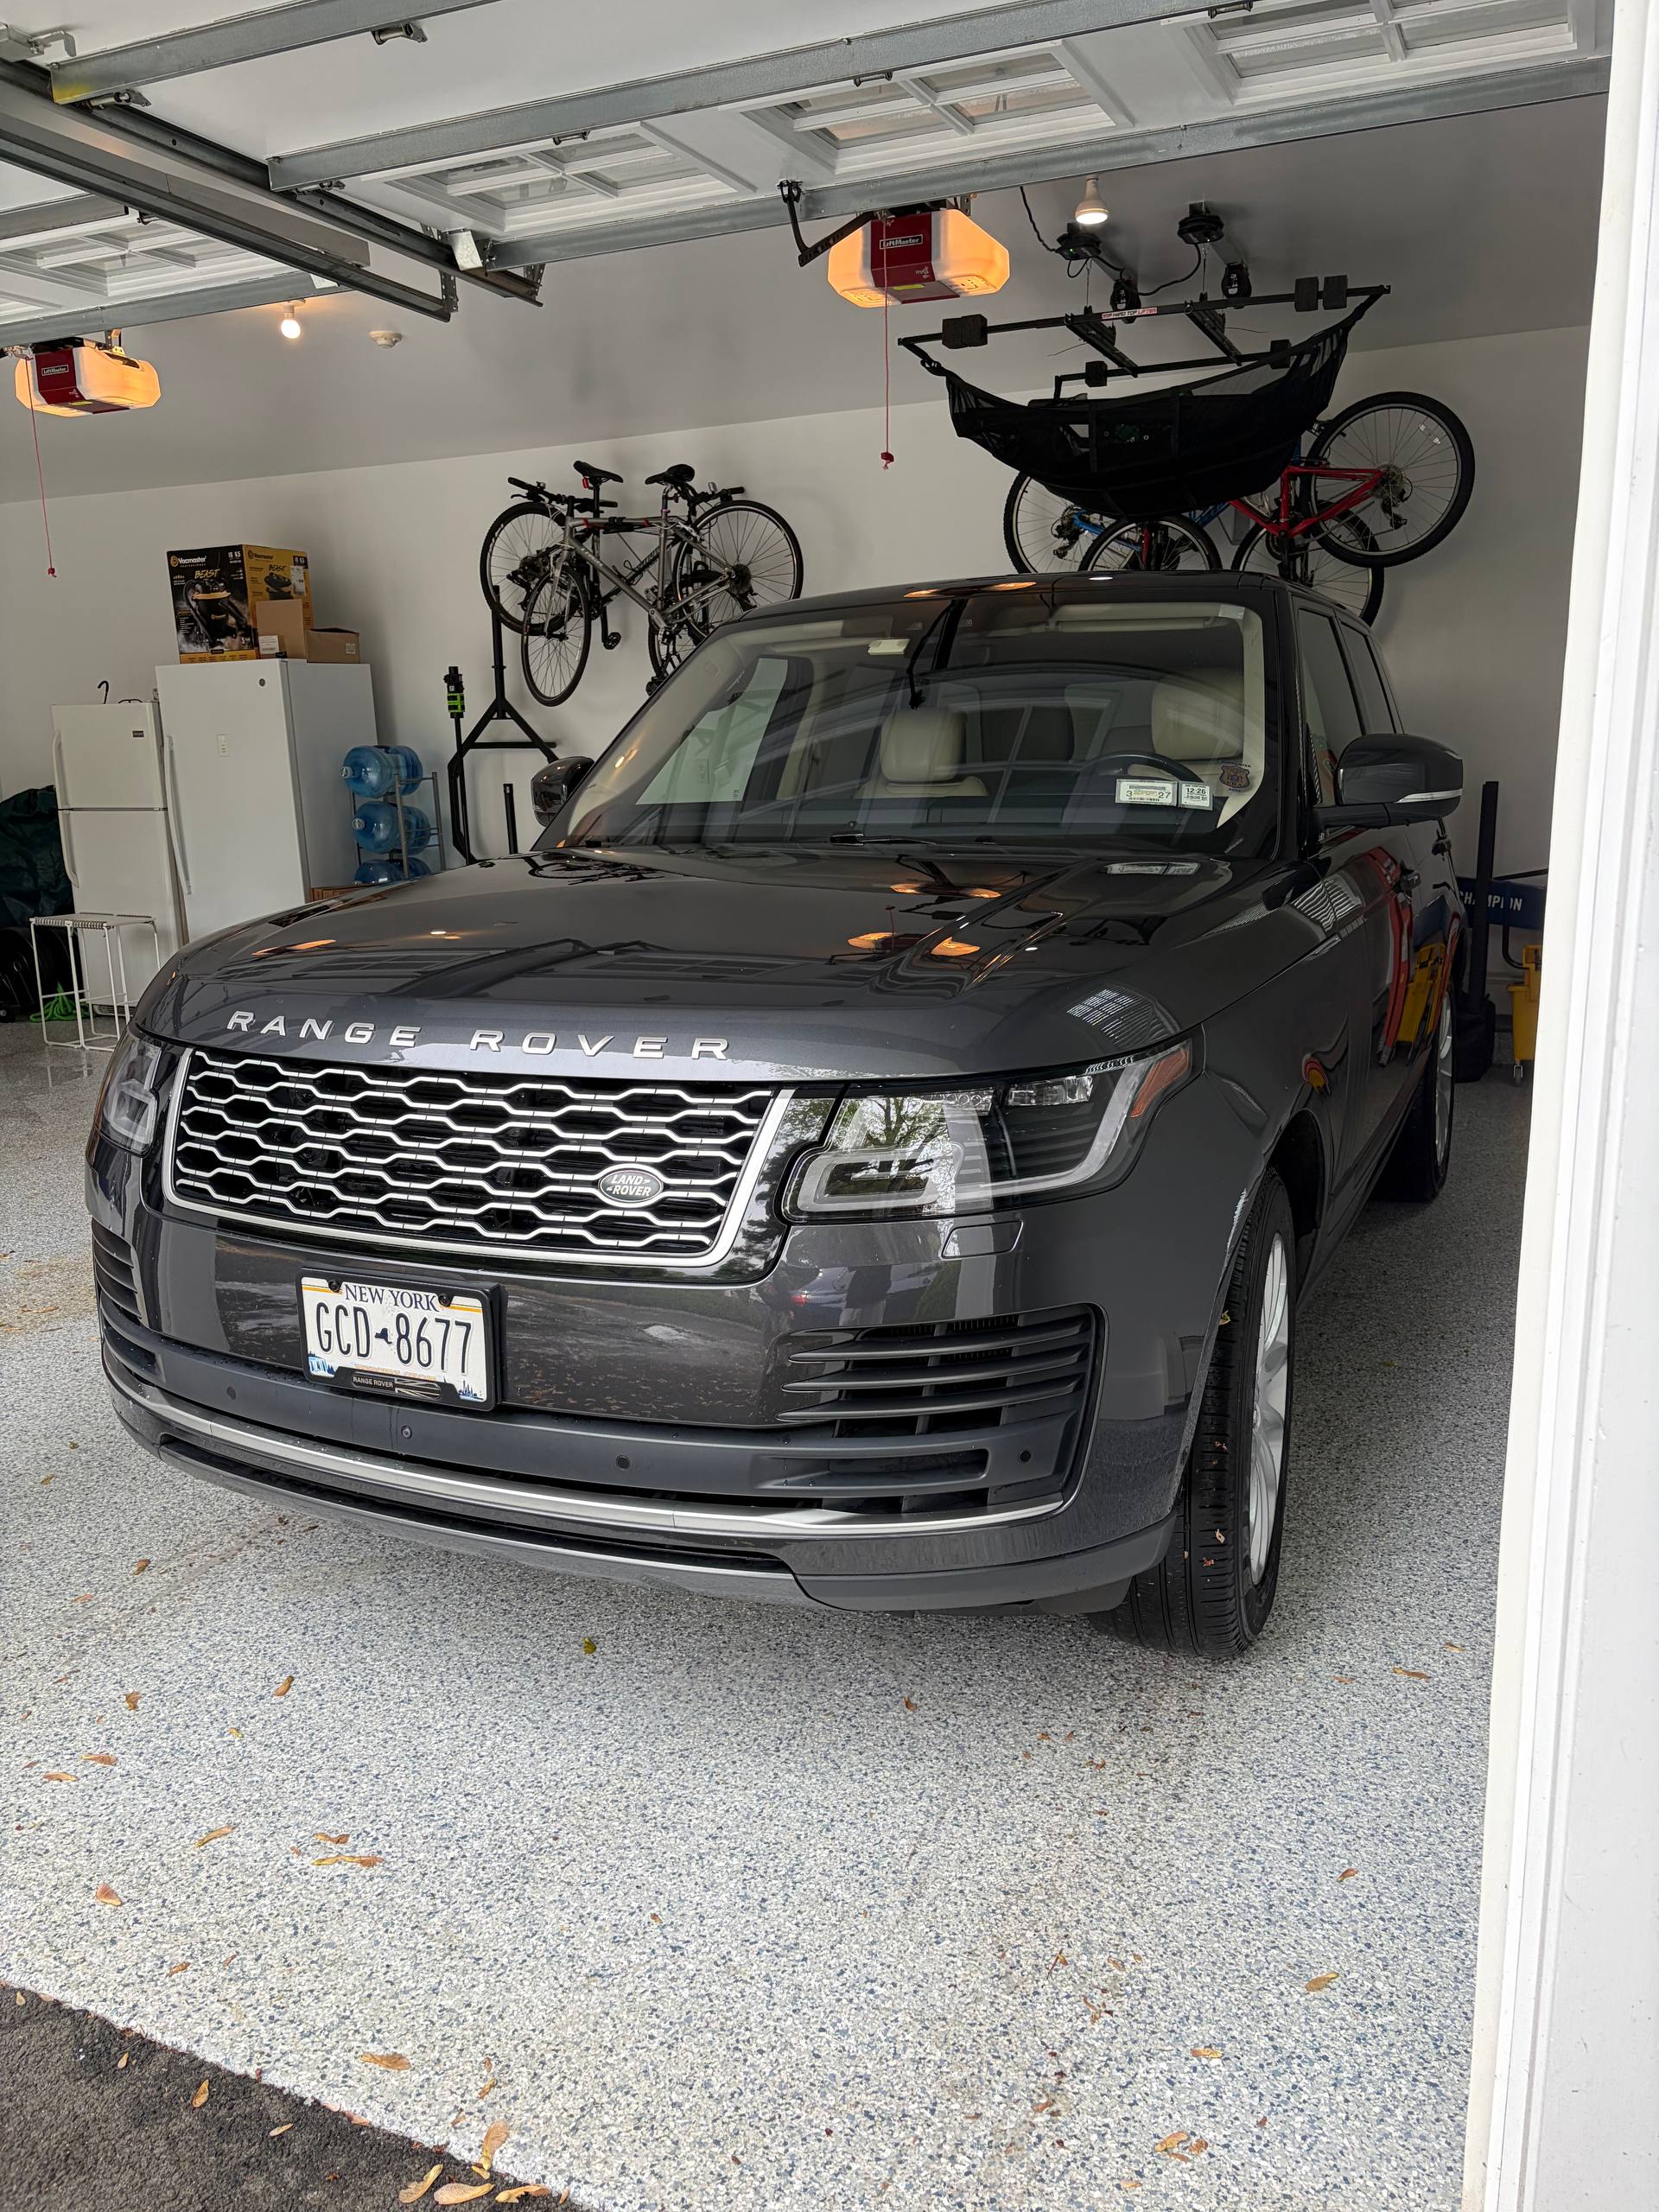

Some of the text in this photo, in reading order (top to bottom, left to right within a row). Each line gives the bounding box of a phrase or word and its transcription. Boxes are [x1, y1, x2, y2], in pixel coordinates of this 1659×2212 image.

[178, 556, 207, 564] Vacmaster
[194, 569, 220, 579] BEAST
[226, 1010, 728, 1061] RANGE ROVER
[610, 1174, 644, 1185] LAND
[612, 1185, 652, 1197] ROVER
[345, 1284, 441, 1312] NEW YORK
[315, 1301, 473, 1374] GCD 8677
[353, 1376, 394, 1389] RANGE ROVER
